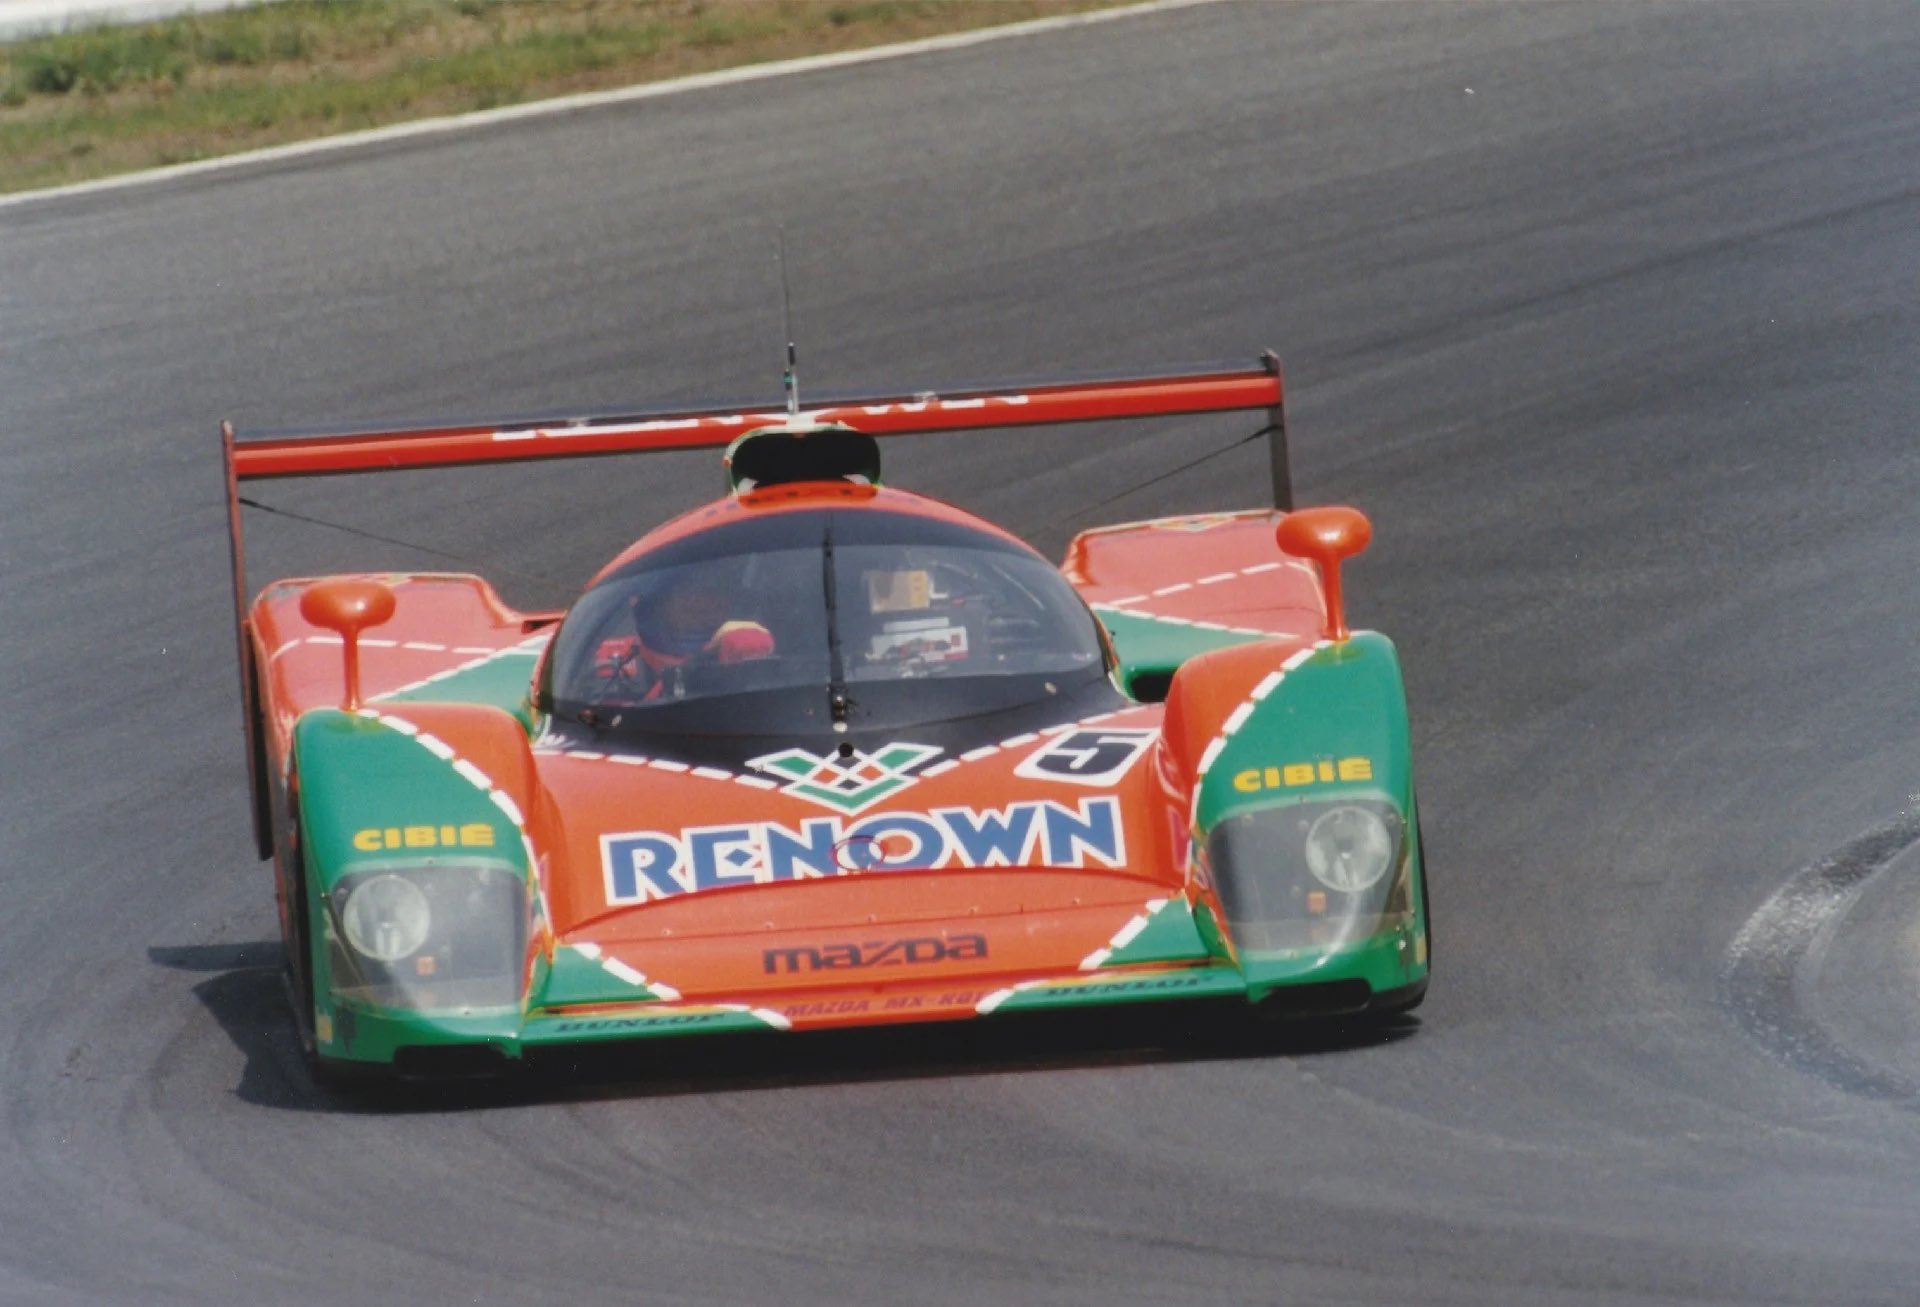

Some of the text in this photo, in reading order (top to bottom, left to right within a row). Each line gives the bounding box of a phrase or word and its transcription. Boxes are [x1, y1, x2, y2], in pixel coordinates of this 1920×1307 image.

[1036, 732, 1150, 775] 5
[1233, 756, 1373, 792] CIBIE
[353, 823, 495, 851] CIBIE
[600, 795, 1127, 905] RENOWN
[785, 1000, 869, 1016] MAZDA
